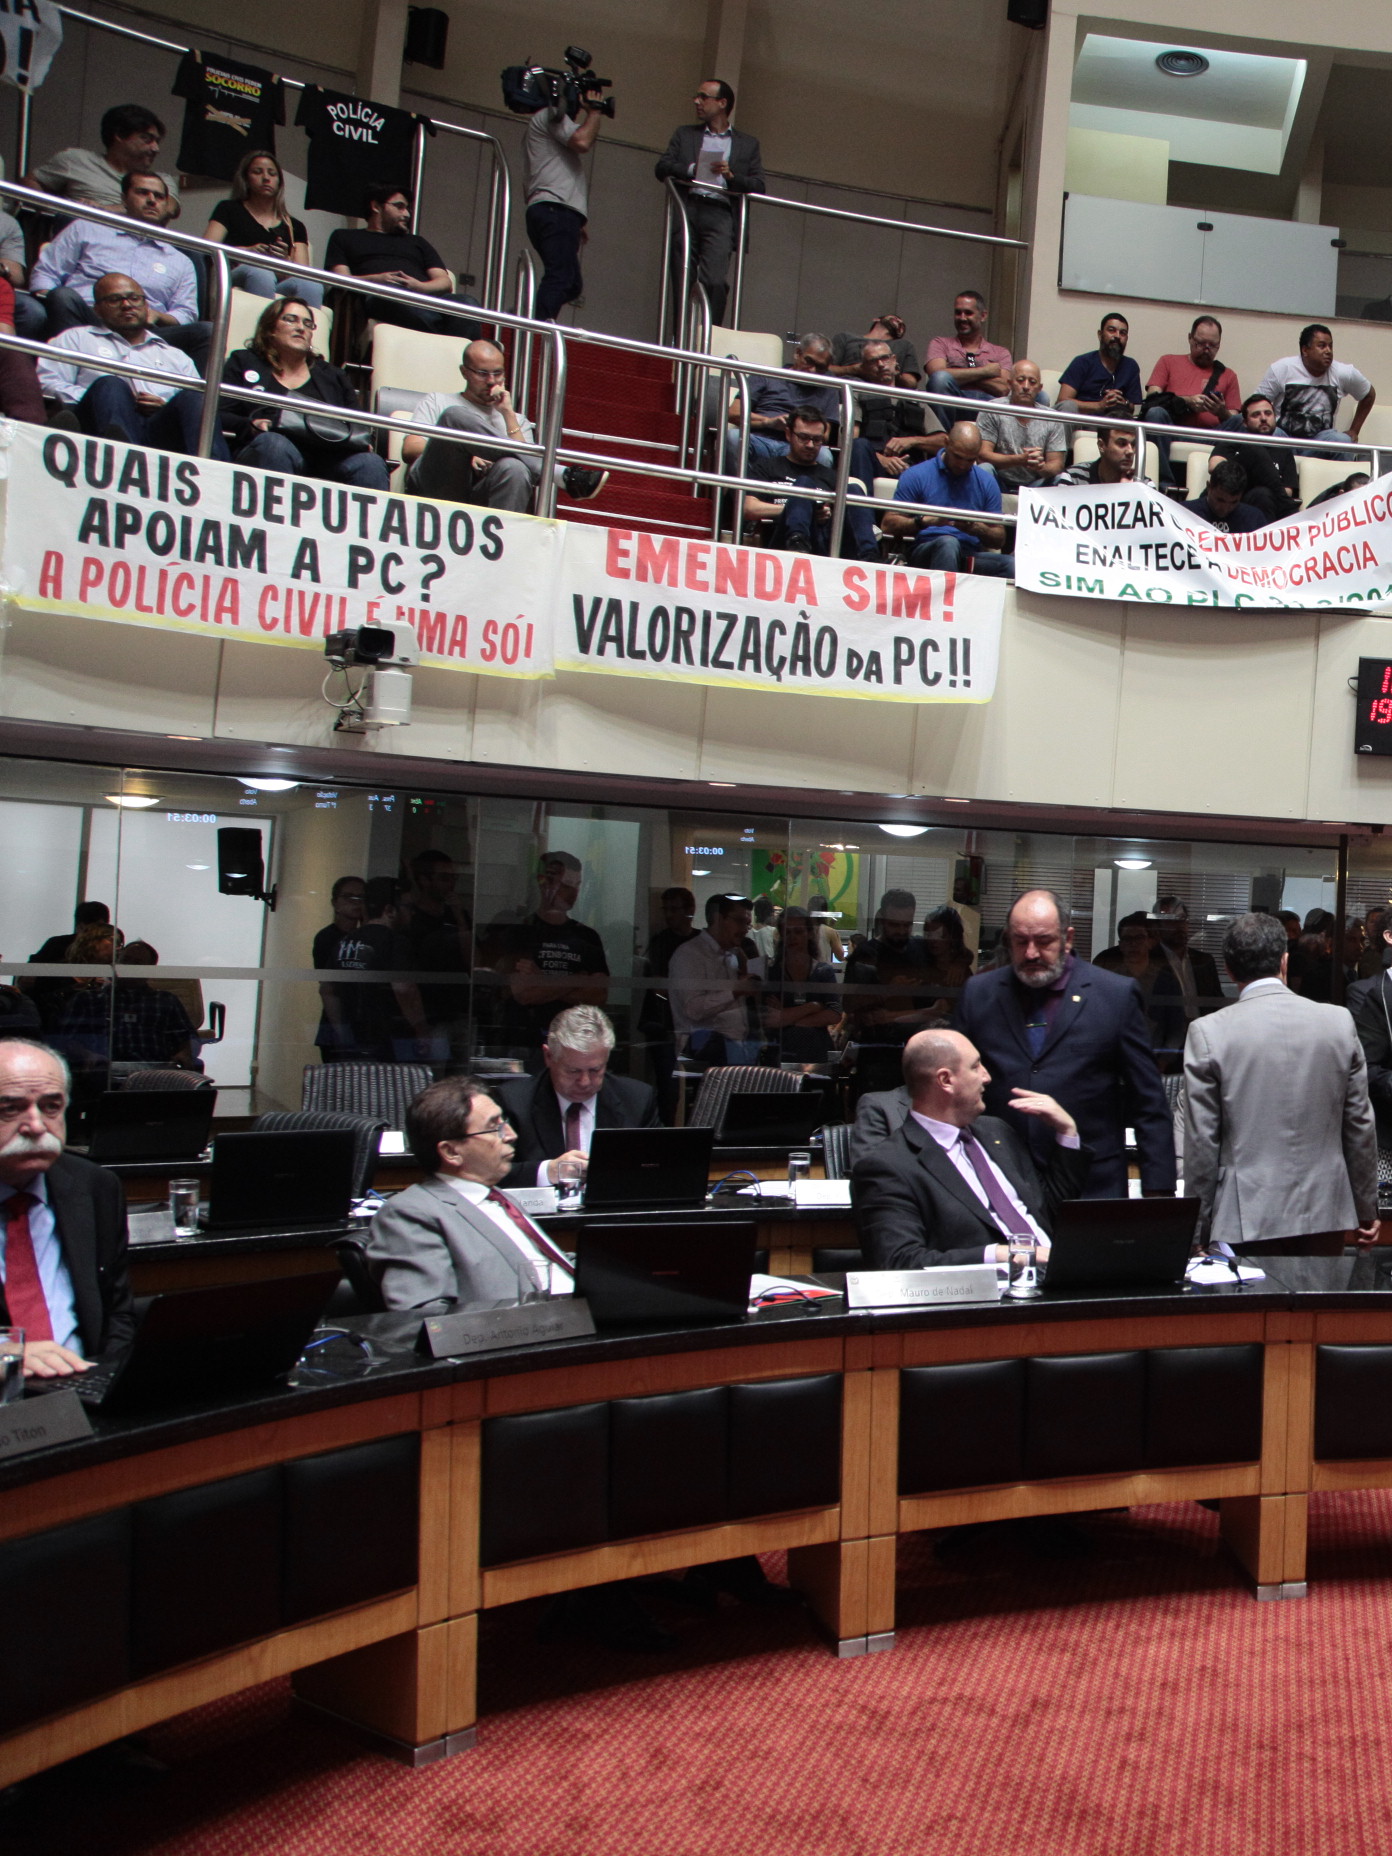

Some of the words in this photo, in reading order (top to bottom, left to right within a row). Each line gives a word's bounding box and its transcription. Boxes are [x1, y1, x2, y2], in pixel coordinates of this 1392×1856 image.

[205, 72, 261, 96] SOCORRO
[326, 102, 386, 132] POLÍCIA
[333, 121, 379, 144] CIVIL
[43, 433, 200, 506] QUAIS
[232, 470, 504, 561] DEPUTADOS
[1030, 500, 1165, 532] VALORIZAR
[78, 497, 267, 574] APOIAM
[291, 538, 321, 583] A
[39, 550, 63, 600] A
[79, 561, 240, 626] POLÍCIA
[605, 528, 819, 606] EMENDA
[842, 565, 956, 622] SIM!
[1039, 571, 1105, 595] SIM
[1117, 583, 1172, 603] AO
[572, 593, 838, 683] VALORIZAÇÃO
[846, 647, 883, 685] DA
[893, 636, 972, 688] PC!!
[900, 1288, 930, 1298] Mauro
[932, 1286, 944, 1297] de
[946, 1284, 974, 1296] Nadal
[463, 1333, 487, 1346] Dep.
